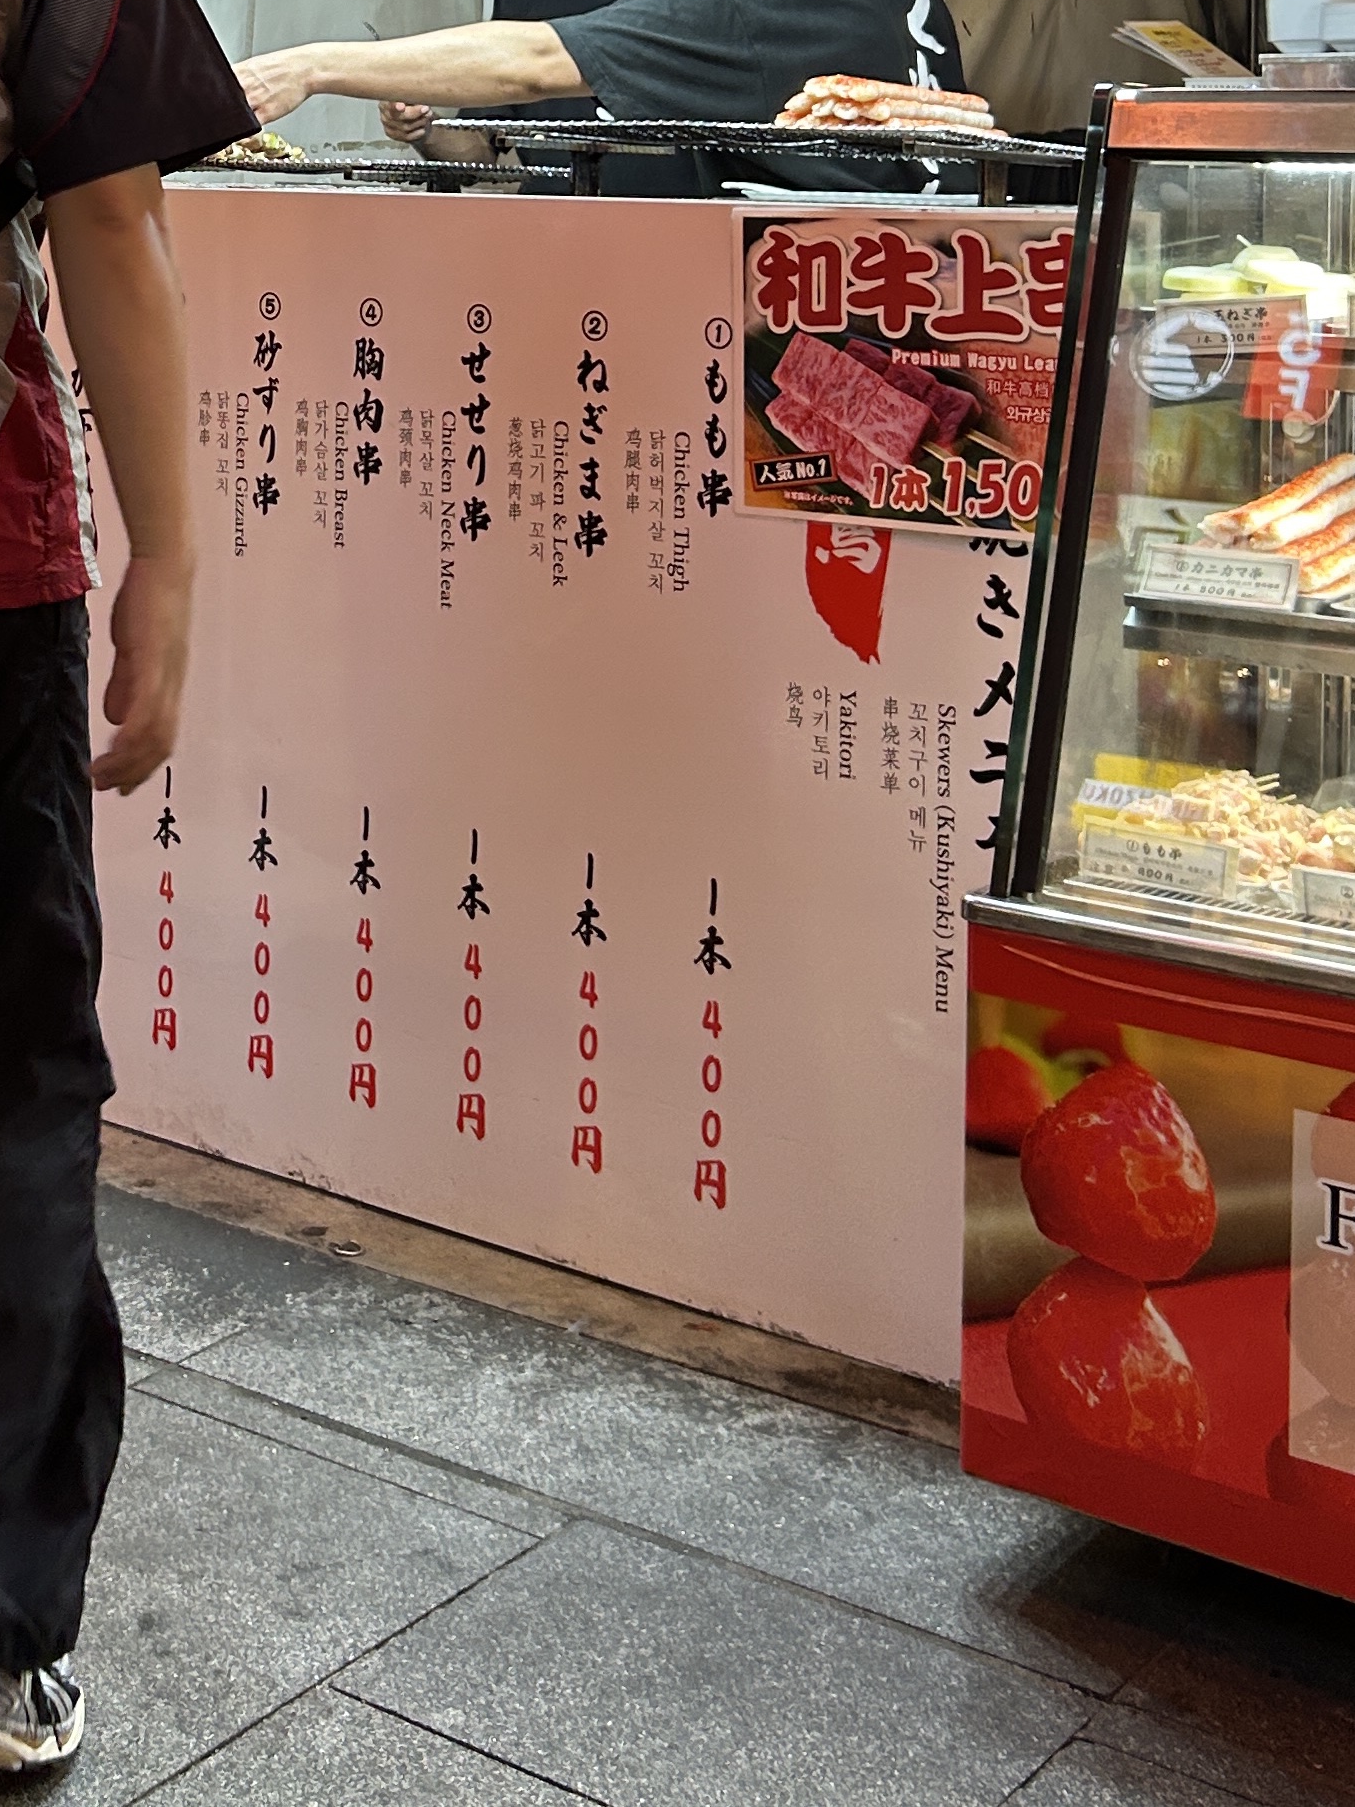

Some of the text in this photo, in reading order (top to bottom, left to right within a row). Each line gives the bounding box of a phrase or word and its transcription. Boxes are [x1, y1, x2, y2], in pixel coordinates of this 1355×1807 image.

[891, 348, 961, 368] Premium
[967, 352, 1017, 371] Wagyu
[986, 379, 1055, 398] 和牛高档
[235, 393, 249, 556] Chicken Gizzards
[334, 402, 349, 548] Chicken Breast
[441, 411, 456, 608] Chicken Neck Meat
[553, 421, 569, 586] Chicken & Leek
[667, 432, 690, 591] Chicken Thigh
[648, 553, 665, 594] 꼬치
[812, 686, 831, 780] 야키토리
[839, 691, 857, 779] Yakitori
[908, 703, 928, 852] 꼬치구이 메뉴
[930, 704, 956, 1012] Skewers (Kushiyaki) Menu
